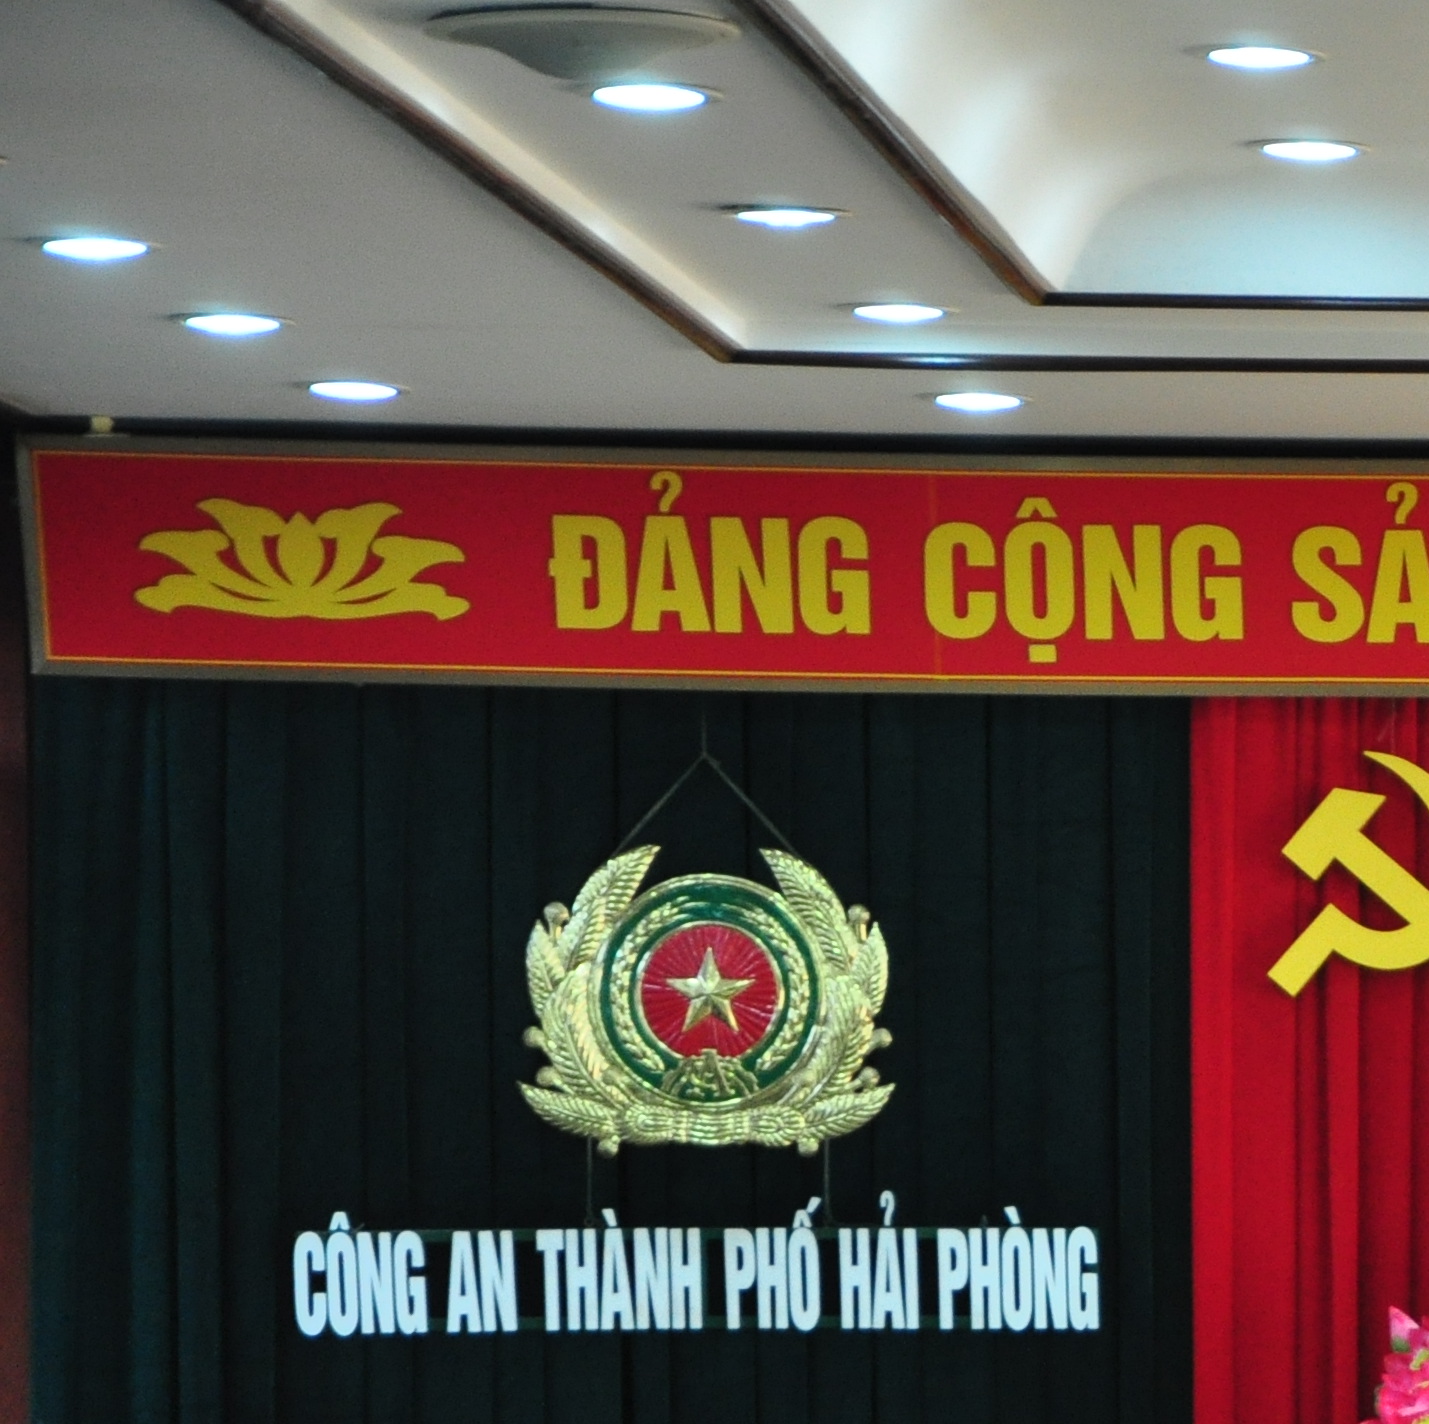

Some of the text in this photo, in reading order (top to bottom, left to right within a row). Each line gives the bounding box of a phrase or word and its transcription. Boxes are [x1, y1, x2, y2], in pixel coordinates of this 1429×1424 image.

[548, 470, 872, 635] ĐẢNG
[924, 497, 1244, 663] CỘNG
[293, 1190, 1101, 1337] CÔNG AN THÀNH PHỐ HẢI PHÒNG
